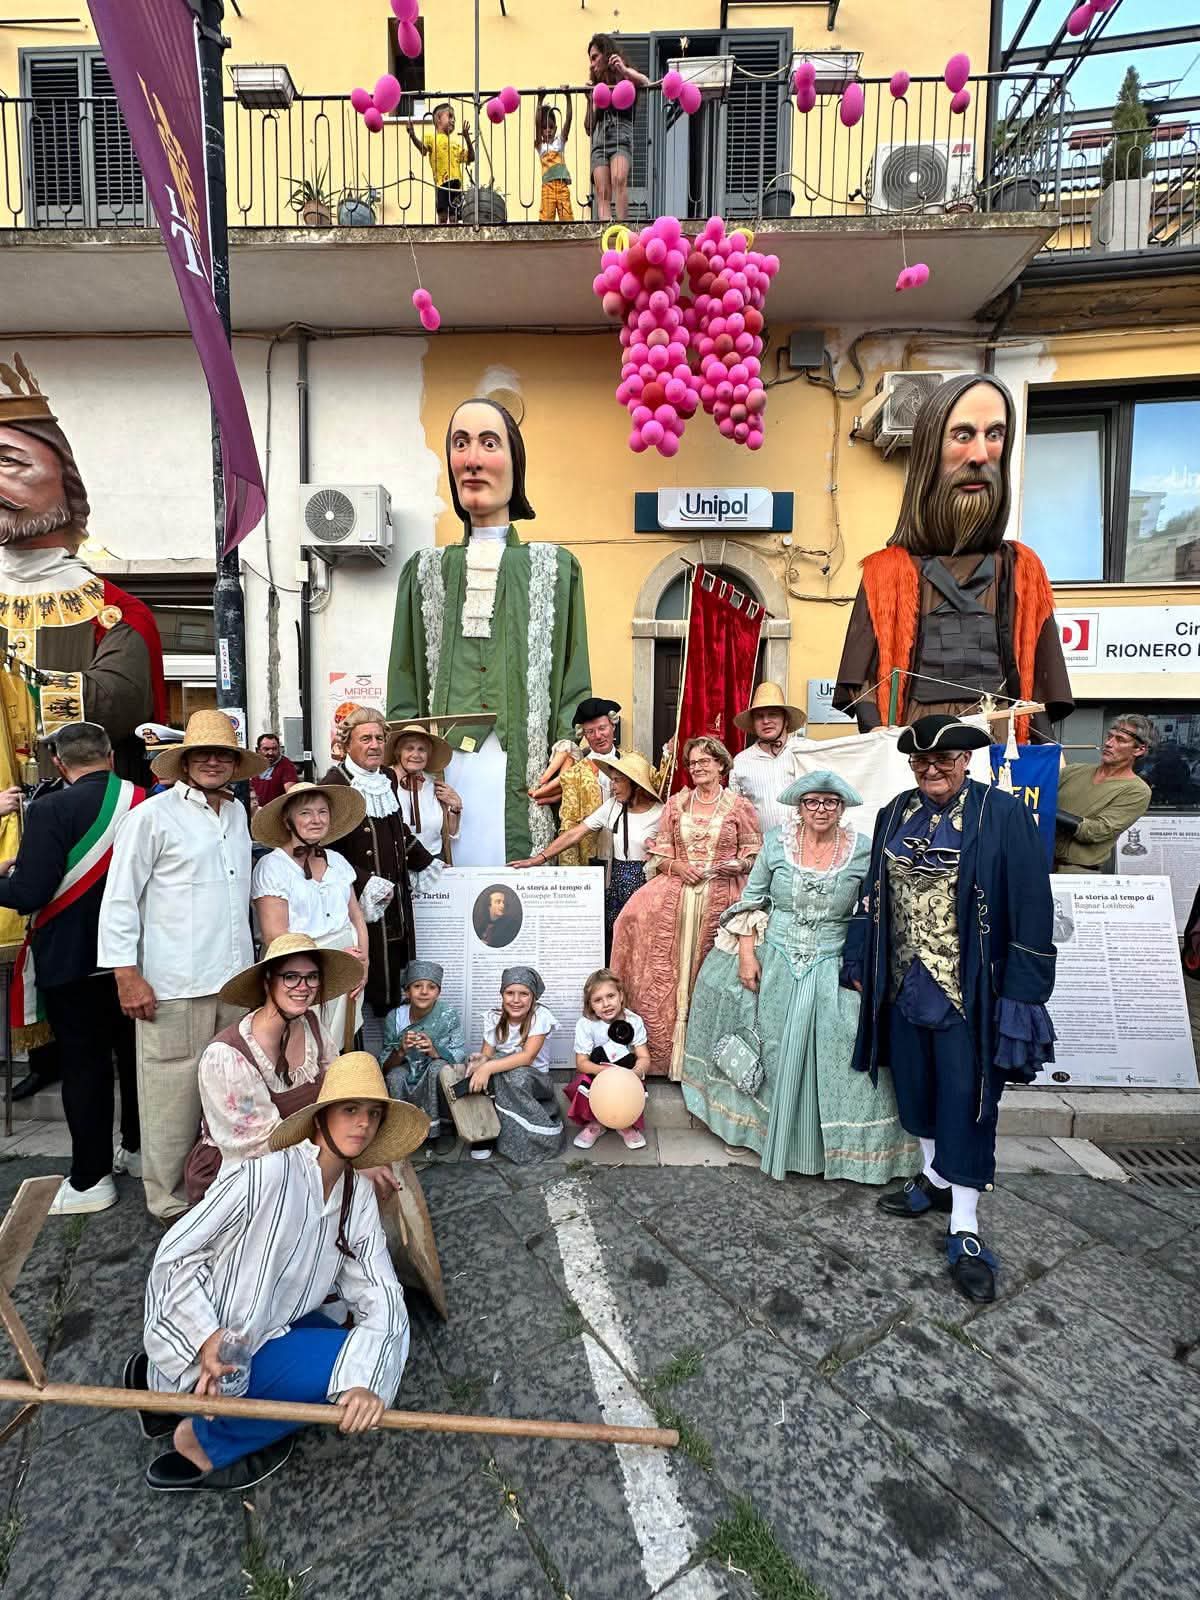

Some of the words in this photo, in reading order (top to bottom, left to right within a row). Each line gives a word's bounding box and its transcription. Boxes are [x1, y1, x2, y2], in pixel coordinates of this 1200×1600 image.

[686, 493, 748, 521] Unipol
[1106, 642, 1192, 658] RIONERO
[1120, 894, 1144, 902] tempo
[1074, 902, 1100, 910] Ragnar
